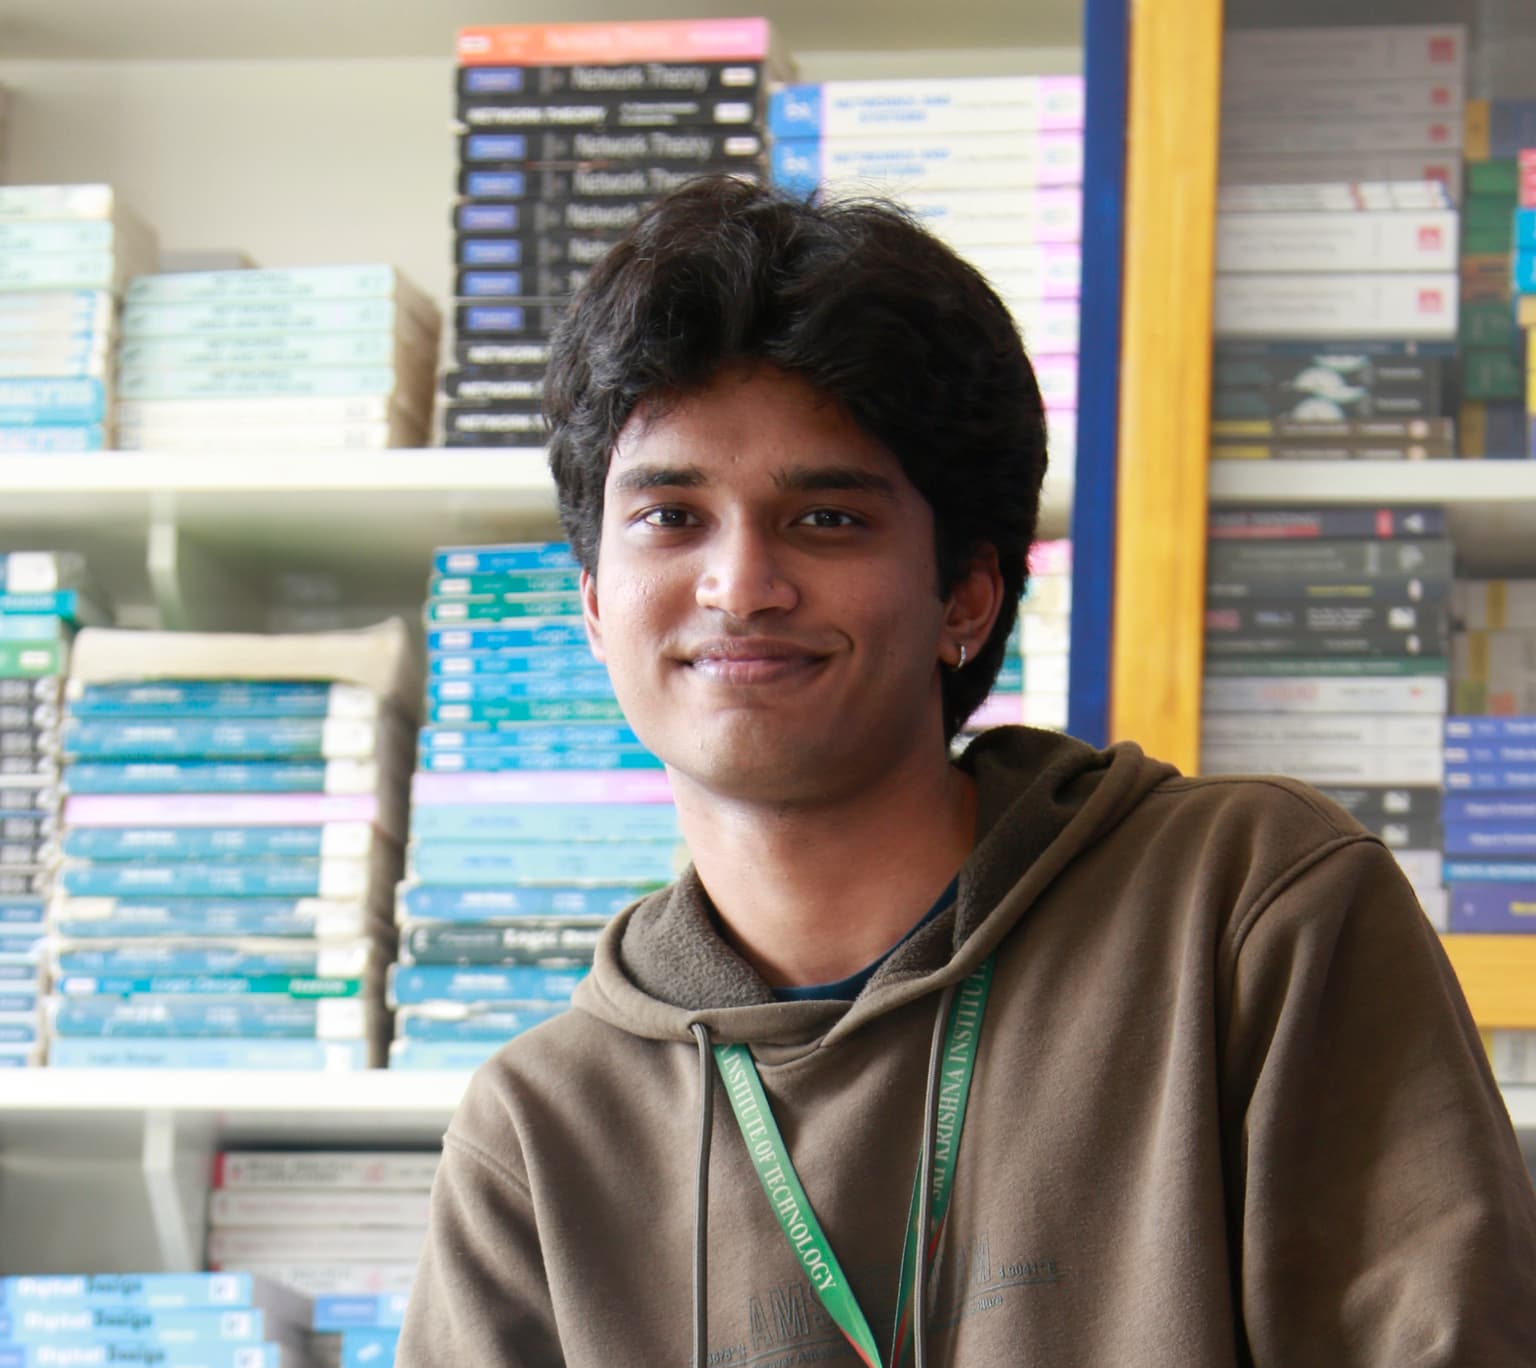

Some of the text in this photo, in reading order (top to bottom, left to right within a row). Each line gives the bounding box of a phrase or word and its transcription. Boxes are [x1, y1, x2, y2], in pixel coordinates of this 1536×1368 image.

[722, 1052, 768, 1141] INSTITUTE
[934, 1067, 966, 1162] KRISHNA
[755, 1138, 776, 1163] OF
[763, 1162, 837, 1292] TECHNOLOGY
